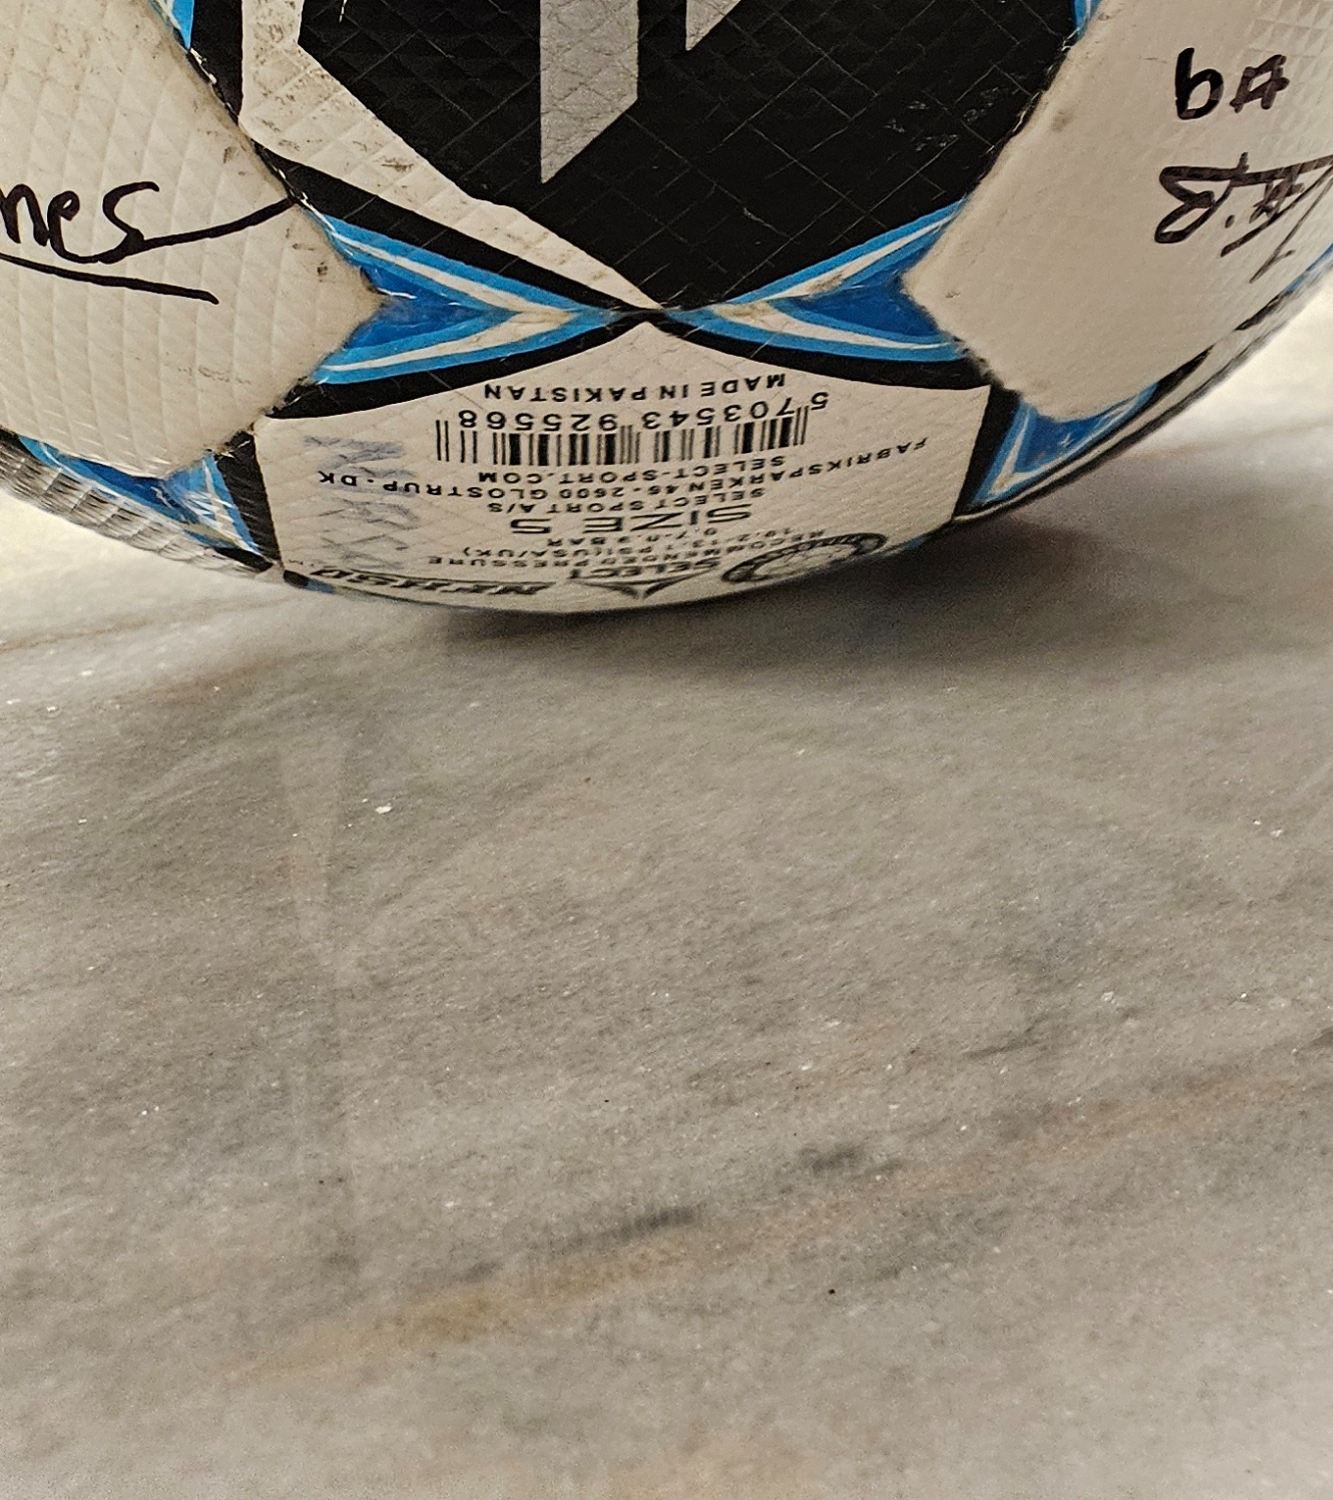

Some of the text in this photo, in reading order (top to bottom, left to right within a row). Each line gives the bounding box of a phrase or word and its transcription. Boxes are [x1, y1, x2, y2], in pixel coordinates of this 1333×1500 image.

[484, 373, 786, 402] MADE IN PAKISTAN
[458, 409, 619, 432] 925568
[478, 455, 786, 485] SELECT-SPORT.COM
[688, 437, 928, 492] FABRIKSPARKEN
[318, 471, 358, 487] DK
[383, 482, 548, 500] GLOSTRUP
[488, 487, 765, 514] SELECT SPORT A/S
[582, 503, 753, 533] SIZE
